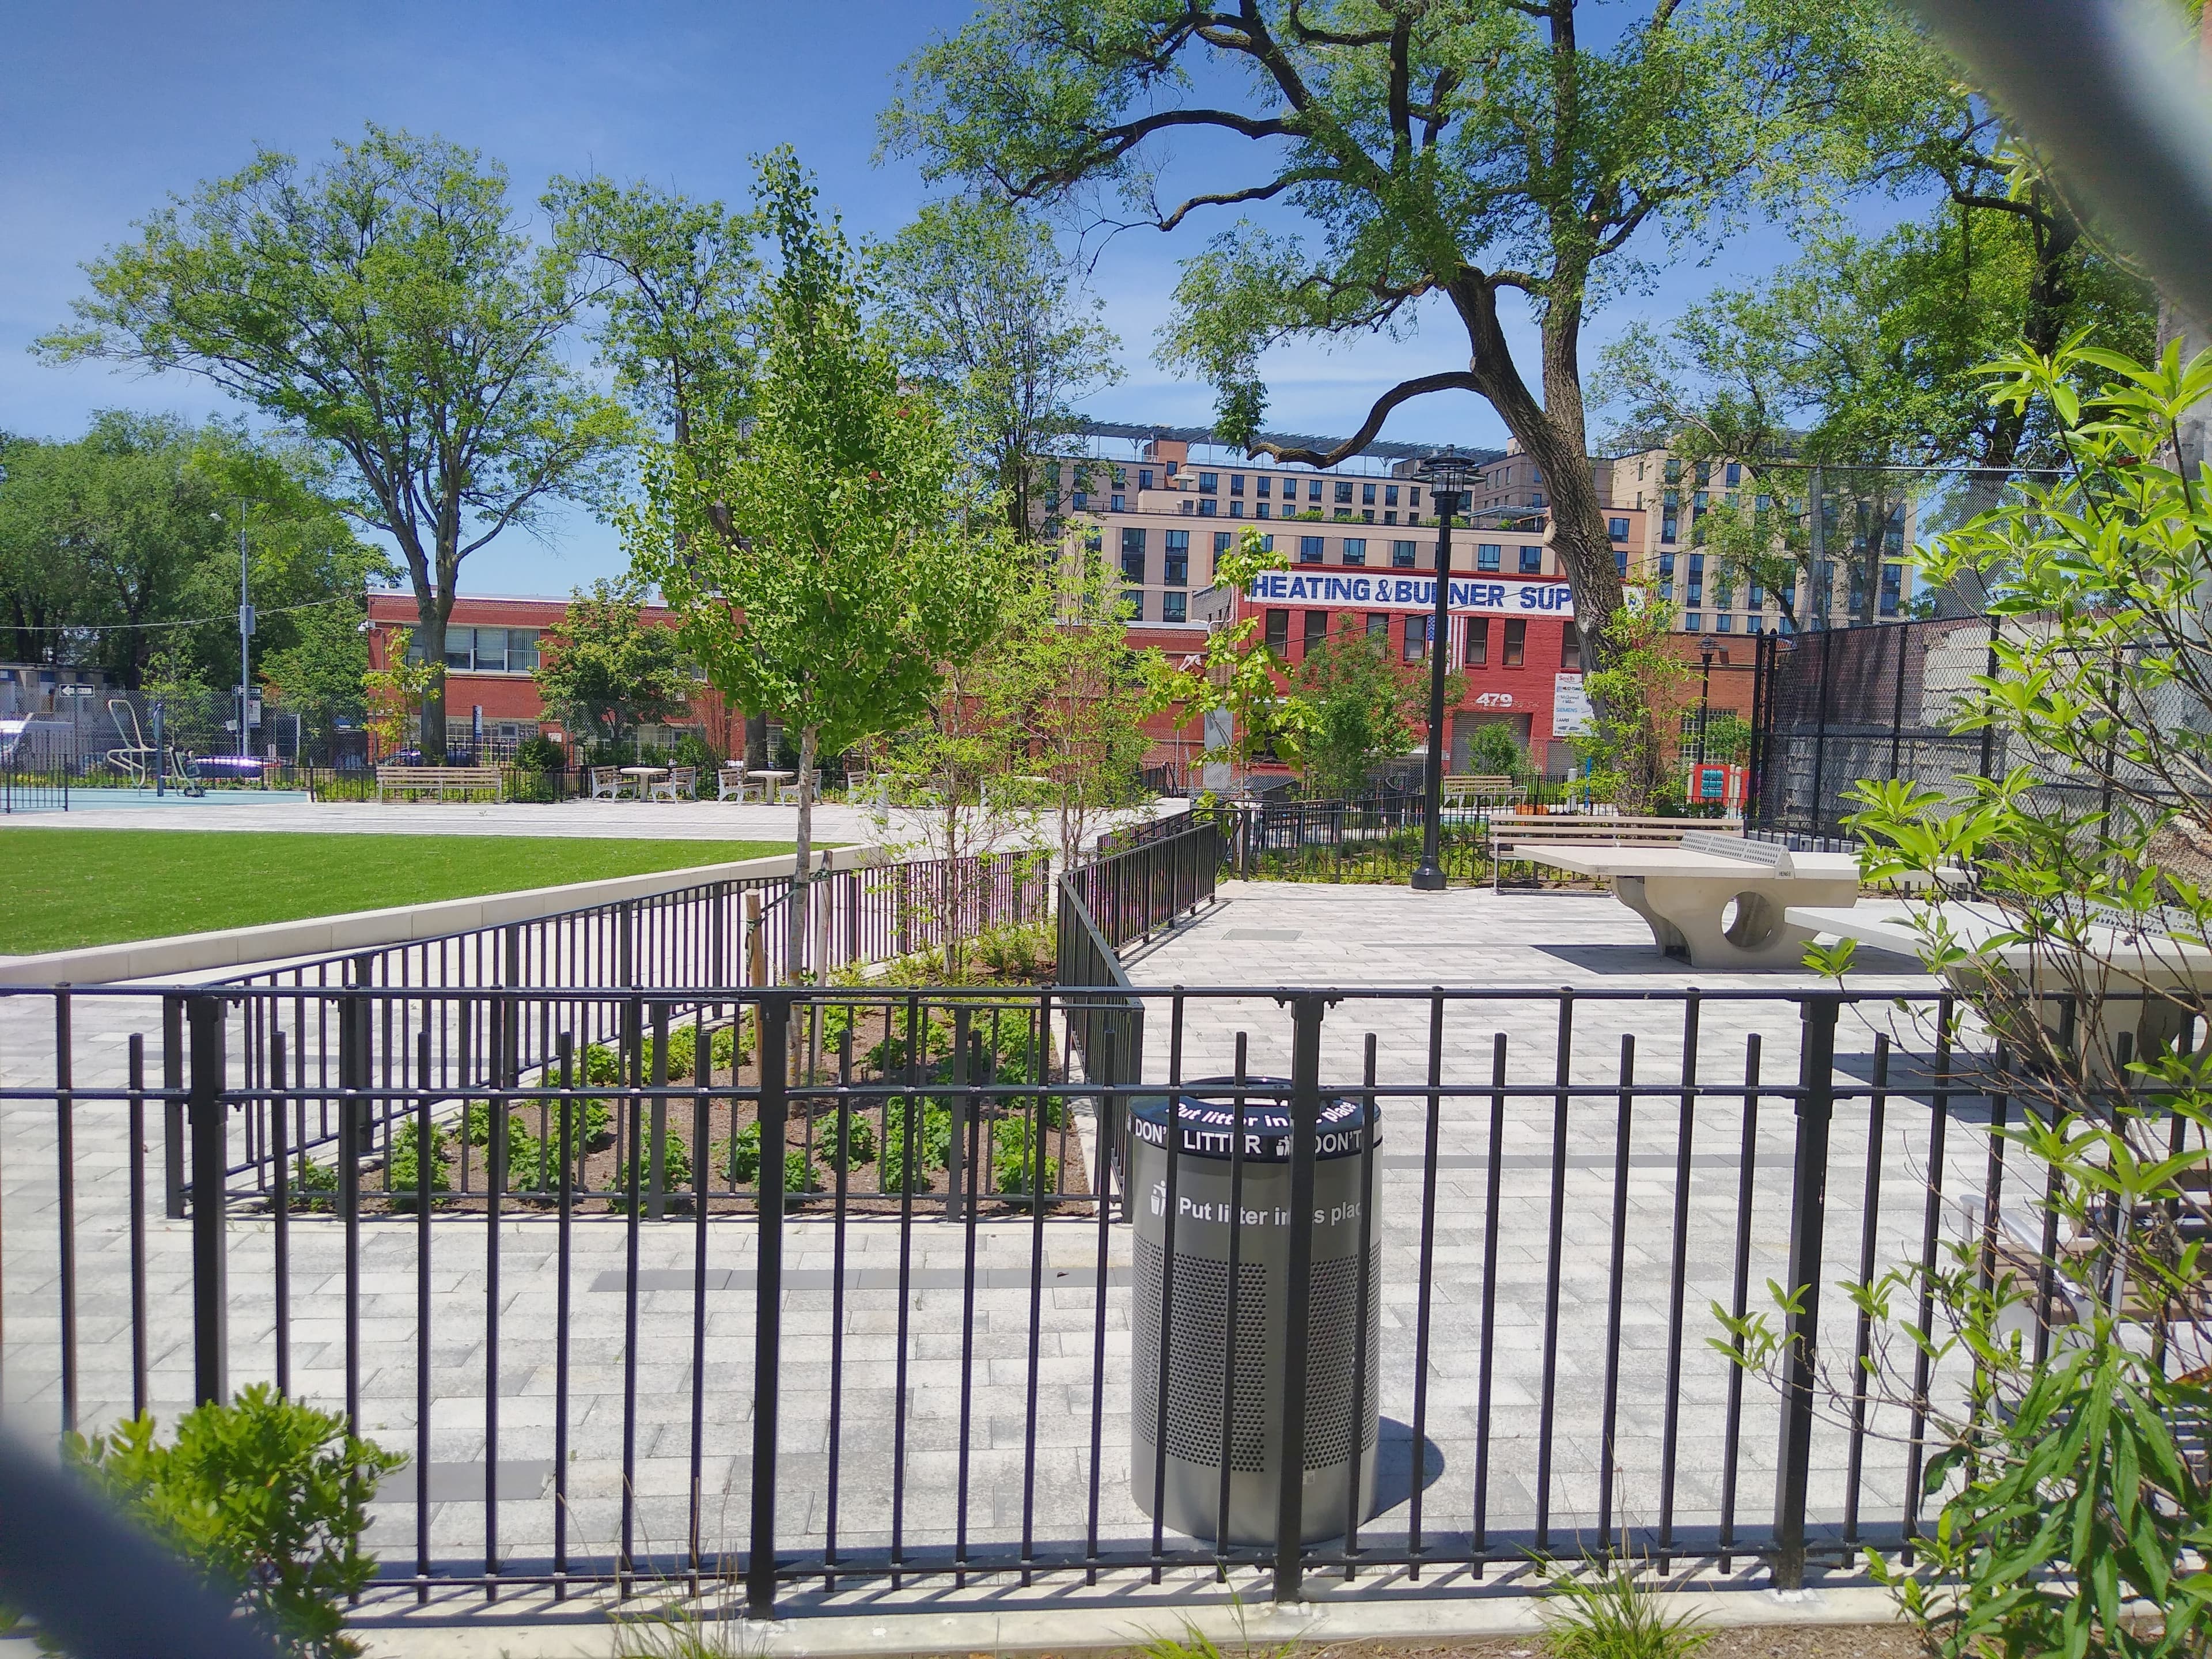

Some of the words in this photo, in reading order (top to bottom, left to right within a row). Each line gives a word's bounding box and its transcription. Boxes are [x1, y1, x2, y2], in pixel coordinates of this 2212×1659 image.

[1252, 575, 1370, 601] HEATING
[1520, 587, 1573, 609] SUP
[1475, 692, 1513, 707] 479
[1264, 1115, 1289, 1127] in
[1321, 1102, 1357, 1122] place
[1135, 1118, 1167, 1143] DON'
[1180, 1196, 1211, 1220] Put
[1218, 1203, 1268, 1225] liter
[1331, 1201, 1361, 1226] plac
